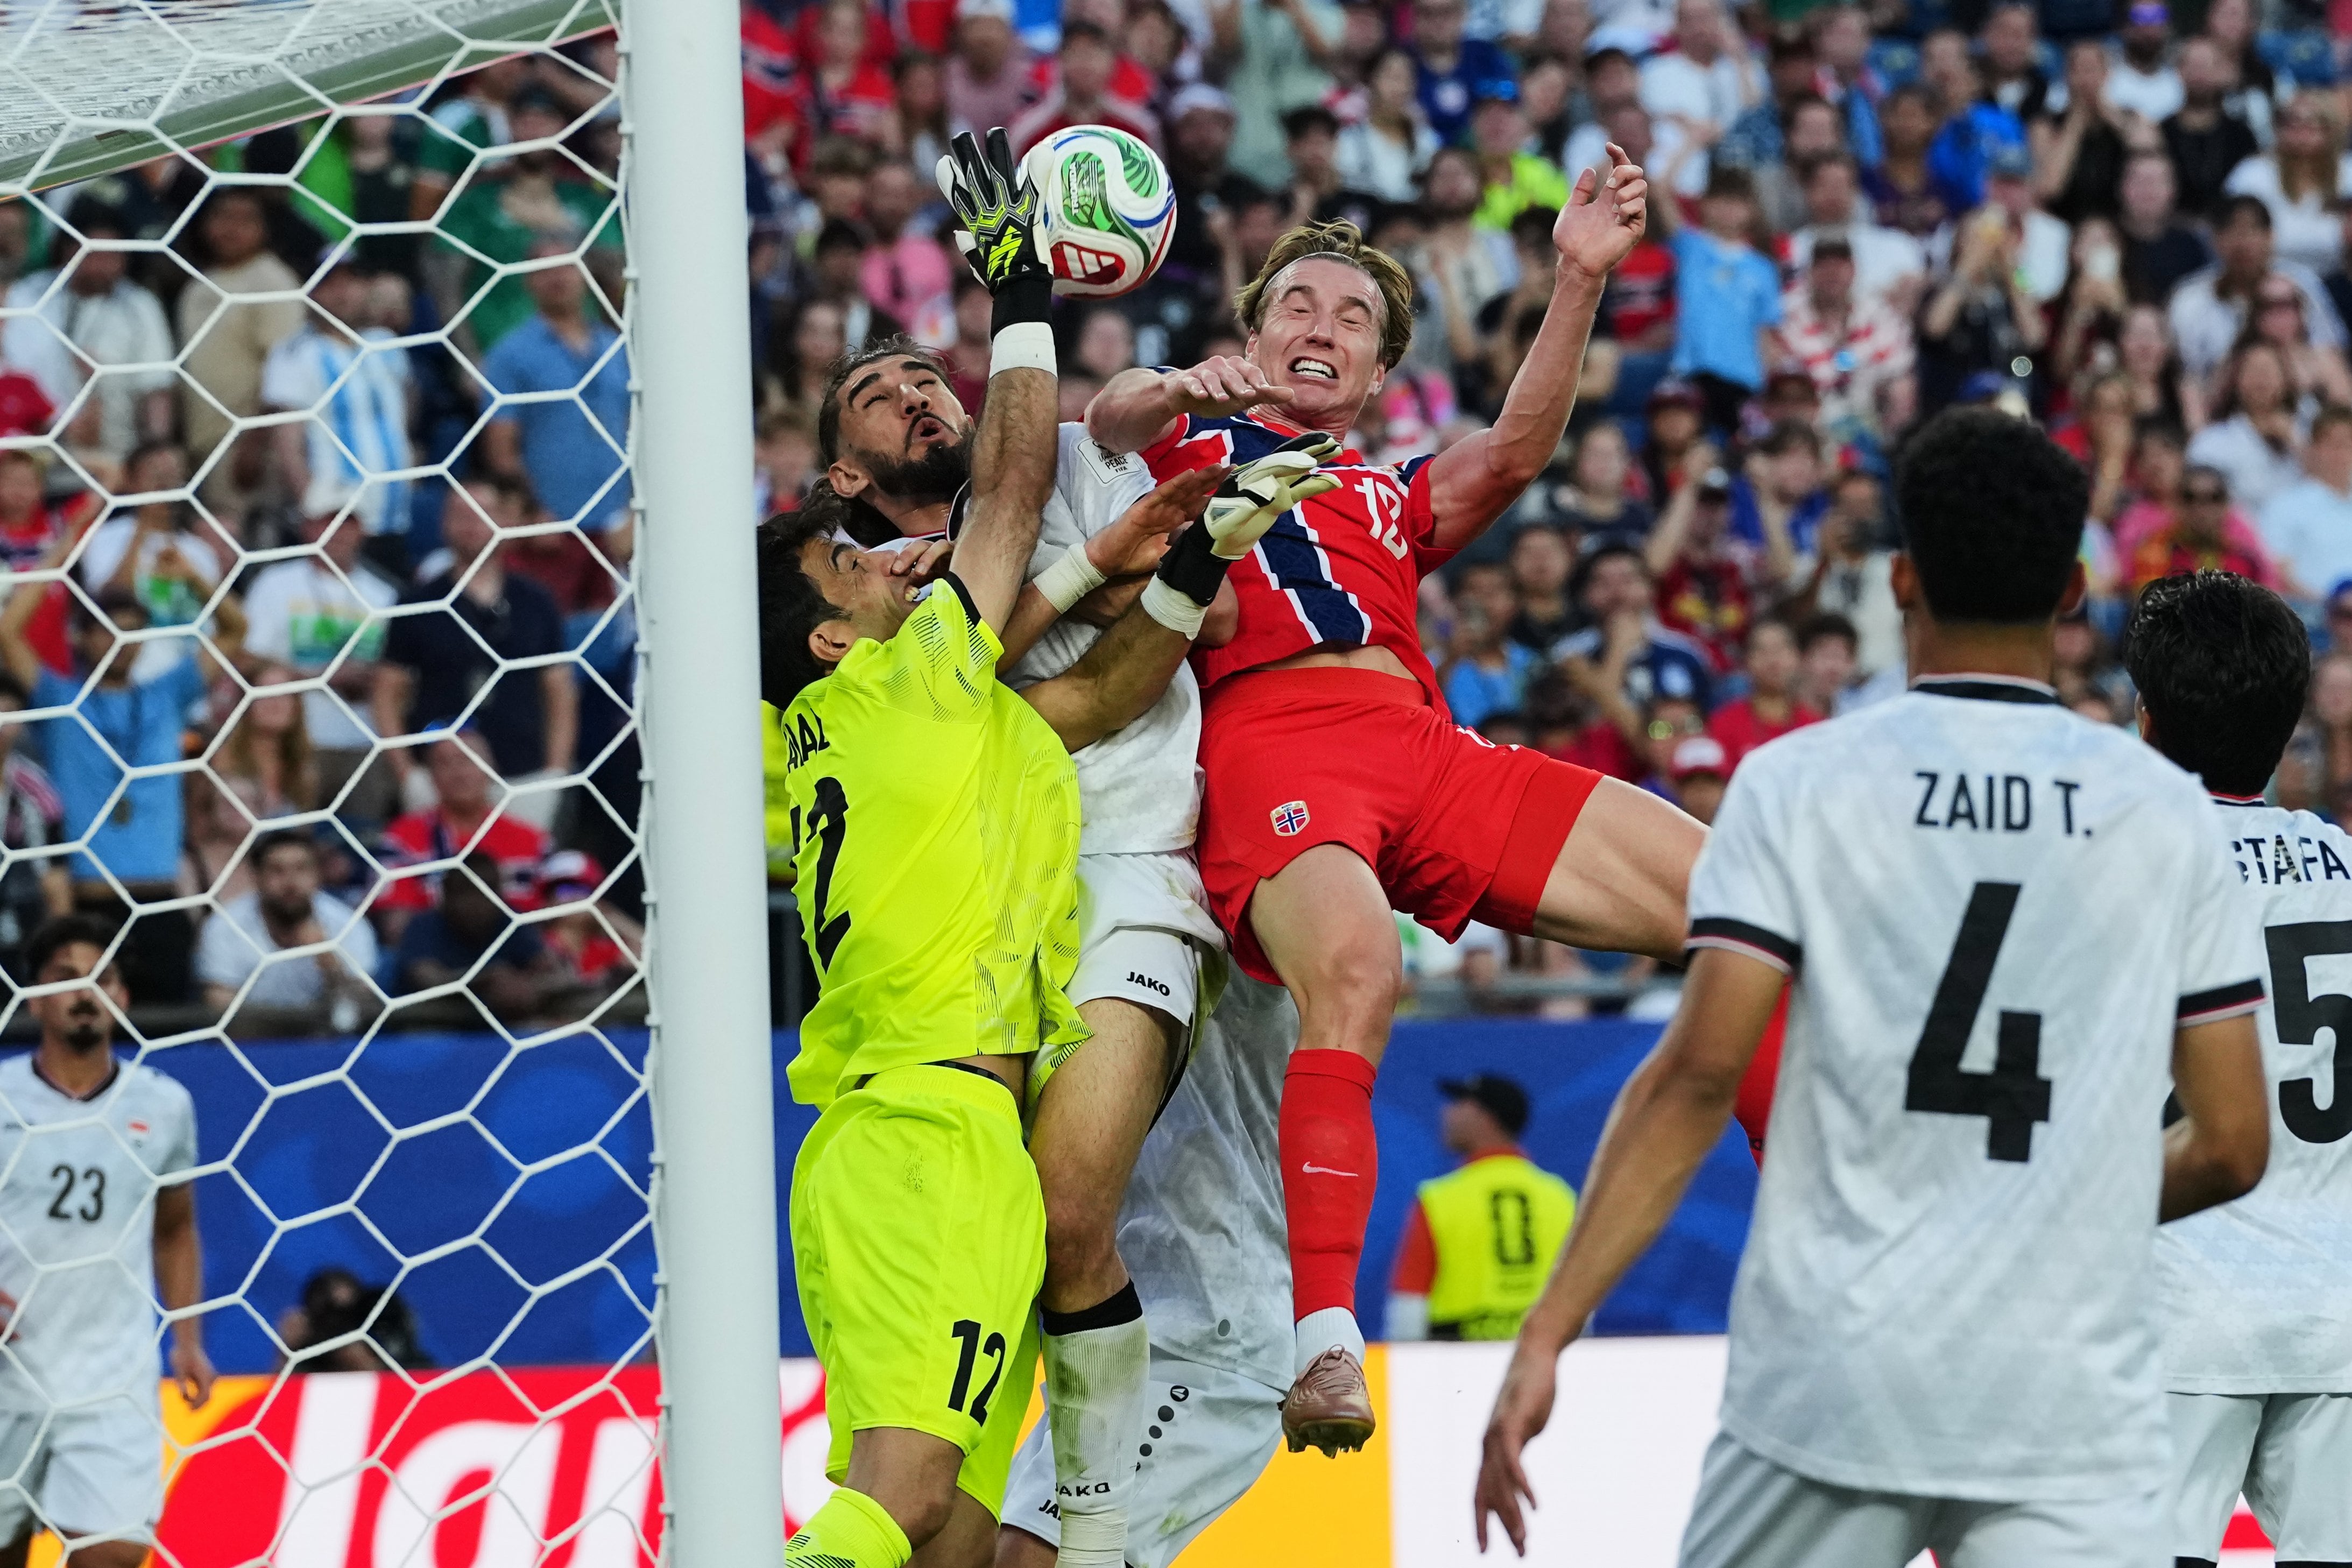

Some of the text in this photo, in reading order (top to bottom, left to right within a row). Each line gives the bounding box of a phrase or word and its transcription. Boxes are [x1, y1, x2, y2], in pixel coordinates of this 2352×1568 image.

[1069, 161, 1079, 216] TRIONDA
[1105, 455, 1128, 470] PEACE
[1915, 771, 2093, 836] ZAID T.
[1126, 971, 1170, 997] JAKO
[1905, 881, 2051, 1162] 4
[2264, 920, 2352, 1144] 5
[48, 1162, 106, 1222] 23
[948, 1319, 1006, 1428] 12
[1039, 1499, 1061, 1521] JA
